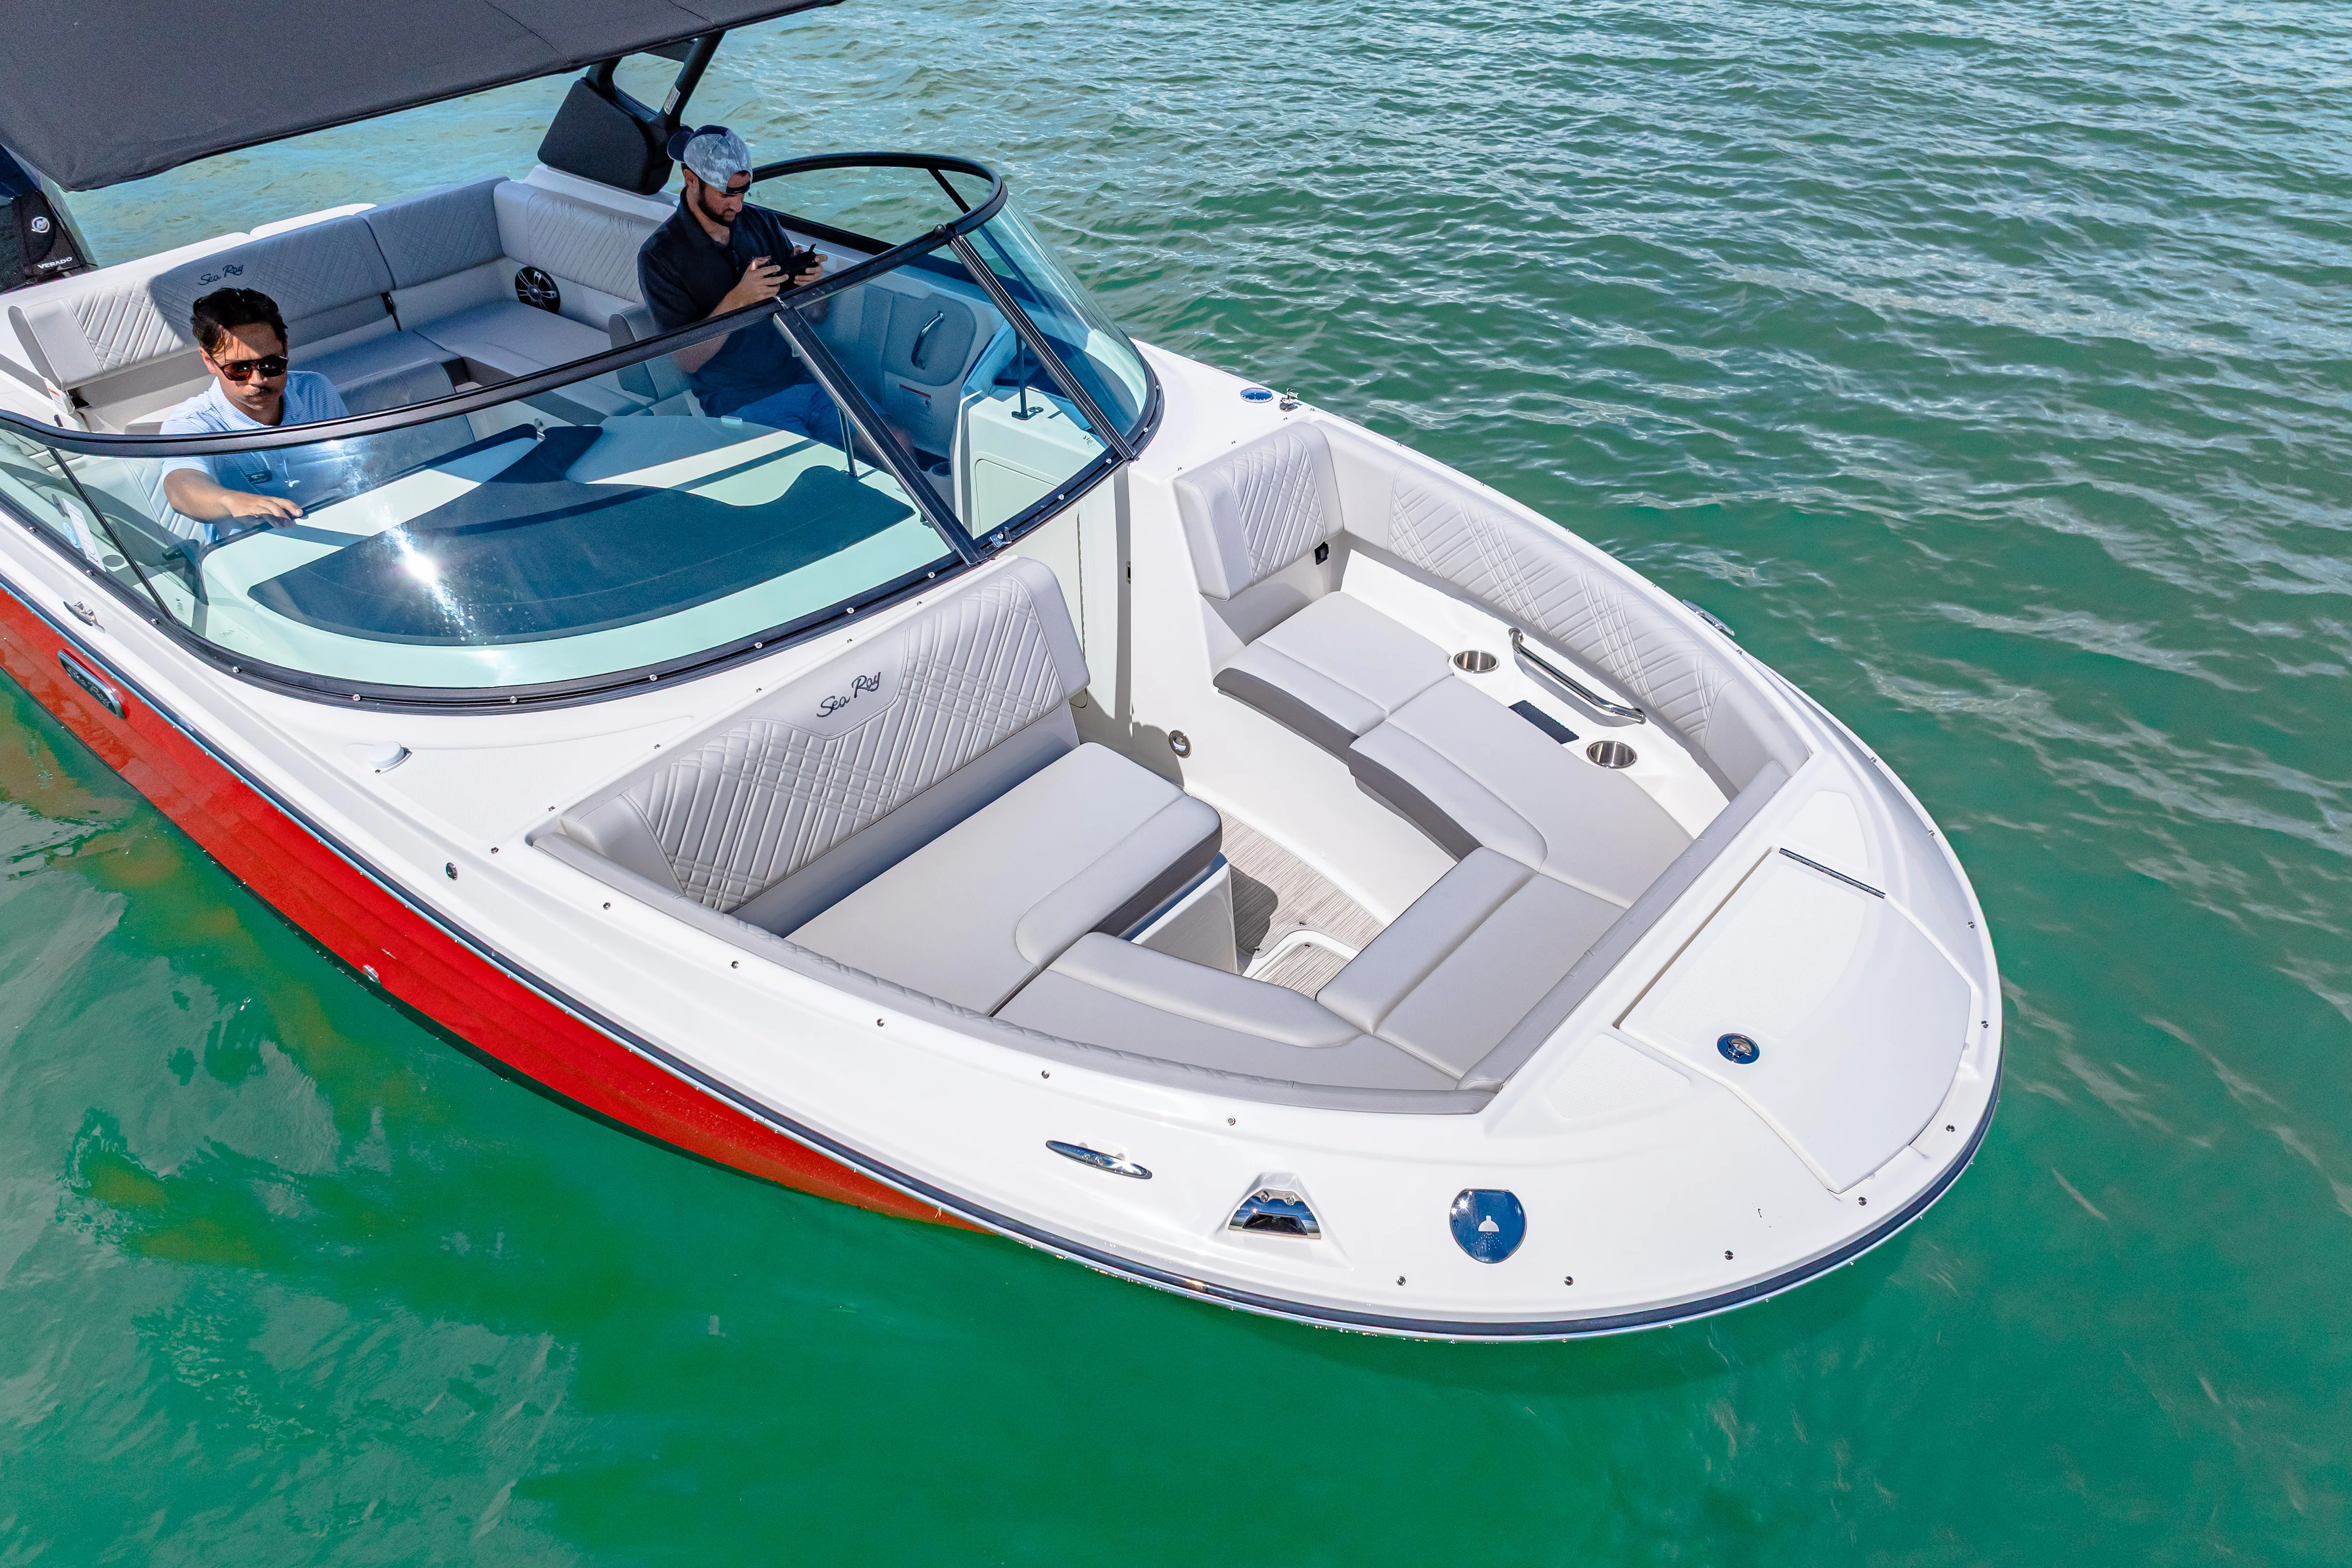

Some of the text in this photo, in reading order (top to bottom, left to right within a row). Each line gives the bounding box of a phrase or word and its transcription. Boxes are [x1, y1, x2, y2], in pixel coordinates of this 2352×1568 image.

[37, 256, 72, 269] VERADO
[198, 264, 244, 285] Sea Ray
[816, 672, 881, 718] Sea Ray
